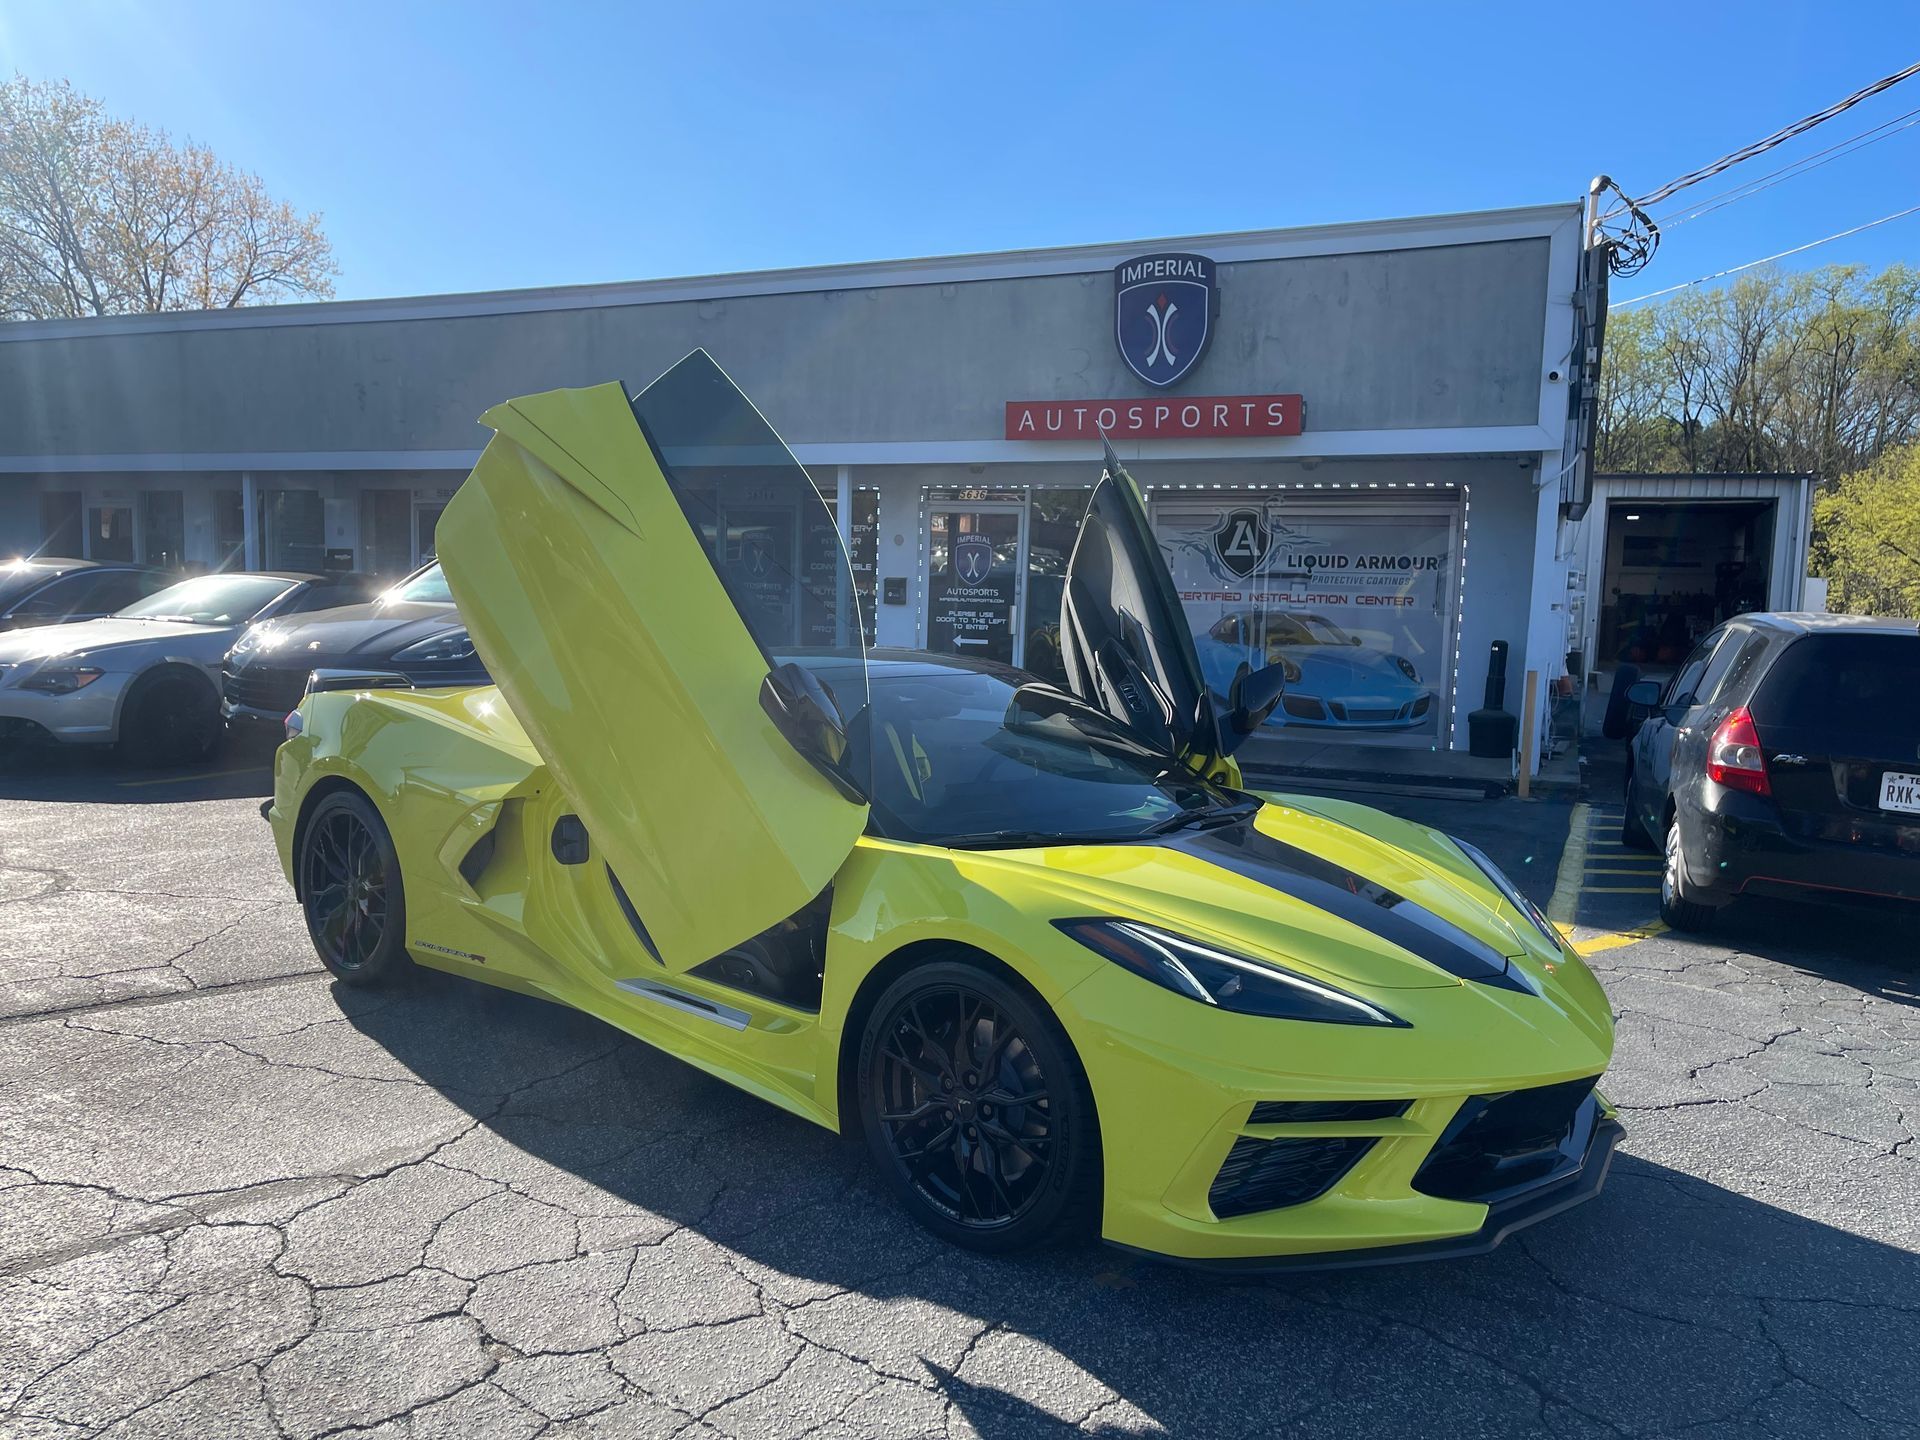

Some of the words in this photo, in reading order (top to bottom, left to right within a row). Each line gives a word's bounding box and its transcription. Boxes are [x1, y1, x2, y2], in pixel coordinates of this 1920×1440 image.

[1121, 259, 1207, 284] IMPERIAL
[1018, 402, 1284, 432] AUTOSPORTS
[959, 490, 987, 500] 5636
[957, 535, 991, 545] IMPERIAL
[1288, 554, 1349, 574] LIQUID
[1355, 554, 1439, 571] ARMOUR
[1311, 574, 1365, 586] PROTECTIVE
[1366, 575, 1412, 586] COATINGS
[946, 587, 999, 597] AUTOSPORTS
[1249, 593, 1348, 604] INSTALLATION
[1356, 595, 1414, 607] CENTER
[948, 610, 977, 618] PLEASE
[979, 610, 994, 618] USE
[936, 616, 956, 624] DOOR
[988, 617, 1007, 625] LEFT
[965, 623, 989, 631] ENTER
[1885, 784, 1914, 805] RXK
